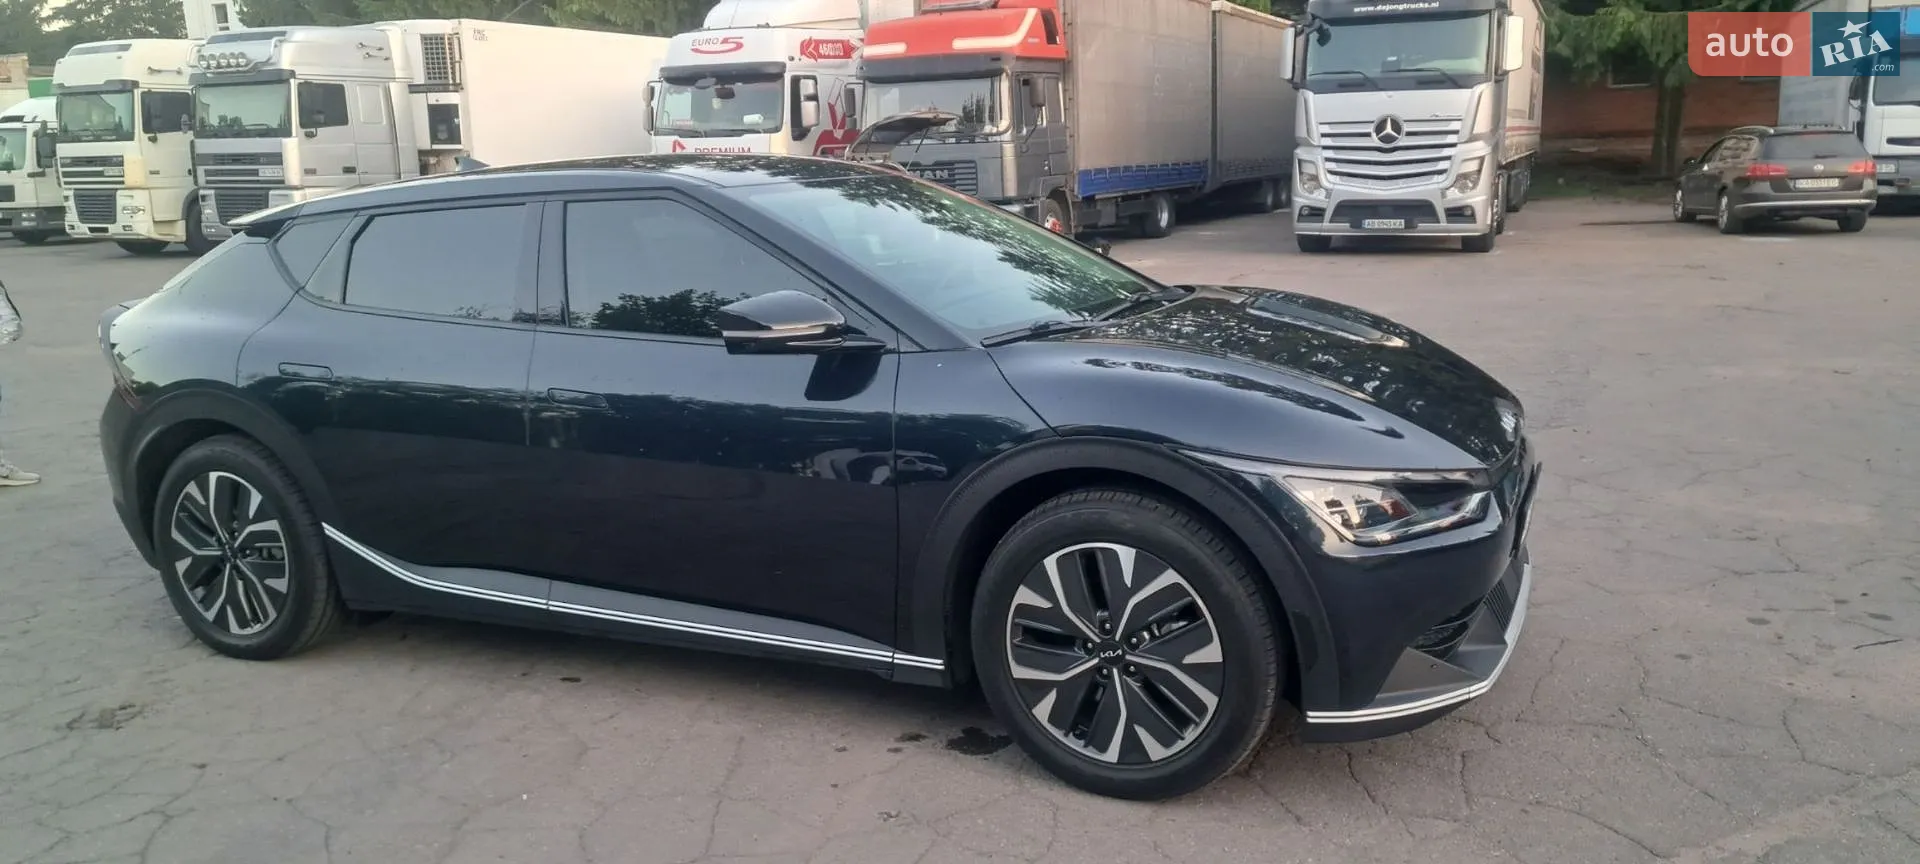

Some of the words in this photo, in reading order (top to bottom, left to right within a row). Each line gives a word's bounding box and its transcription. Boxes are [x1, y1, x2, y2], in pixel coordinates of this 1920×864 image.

[1353, 1, 1440, 12] www.dejongtrucks.nl
[691, 37, 719, 47] EURO
[909, 170, 949, 179] MAN
